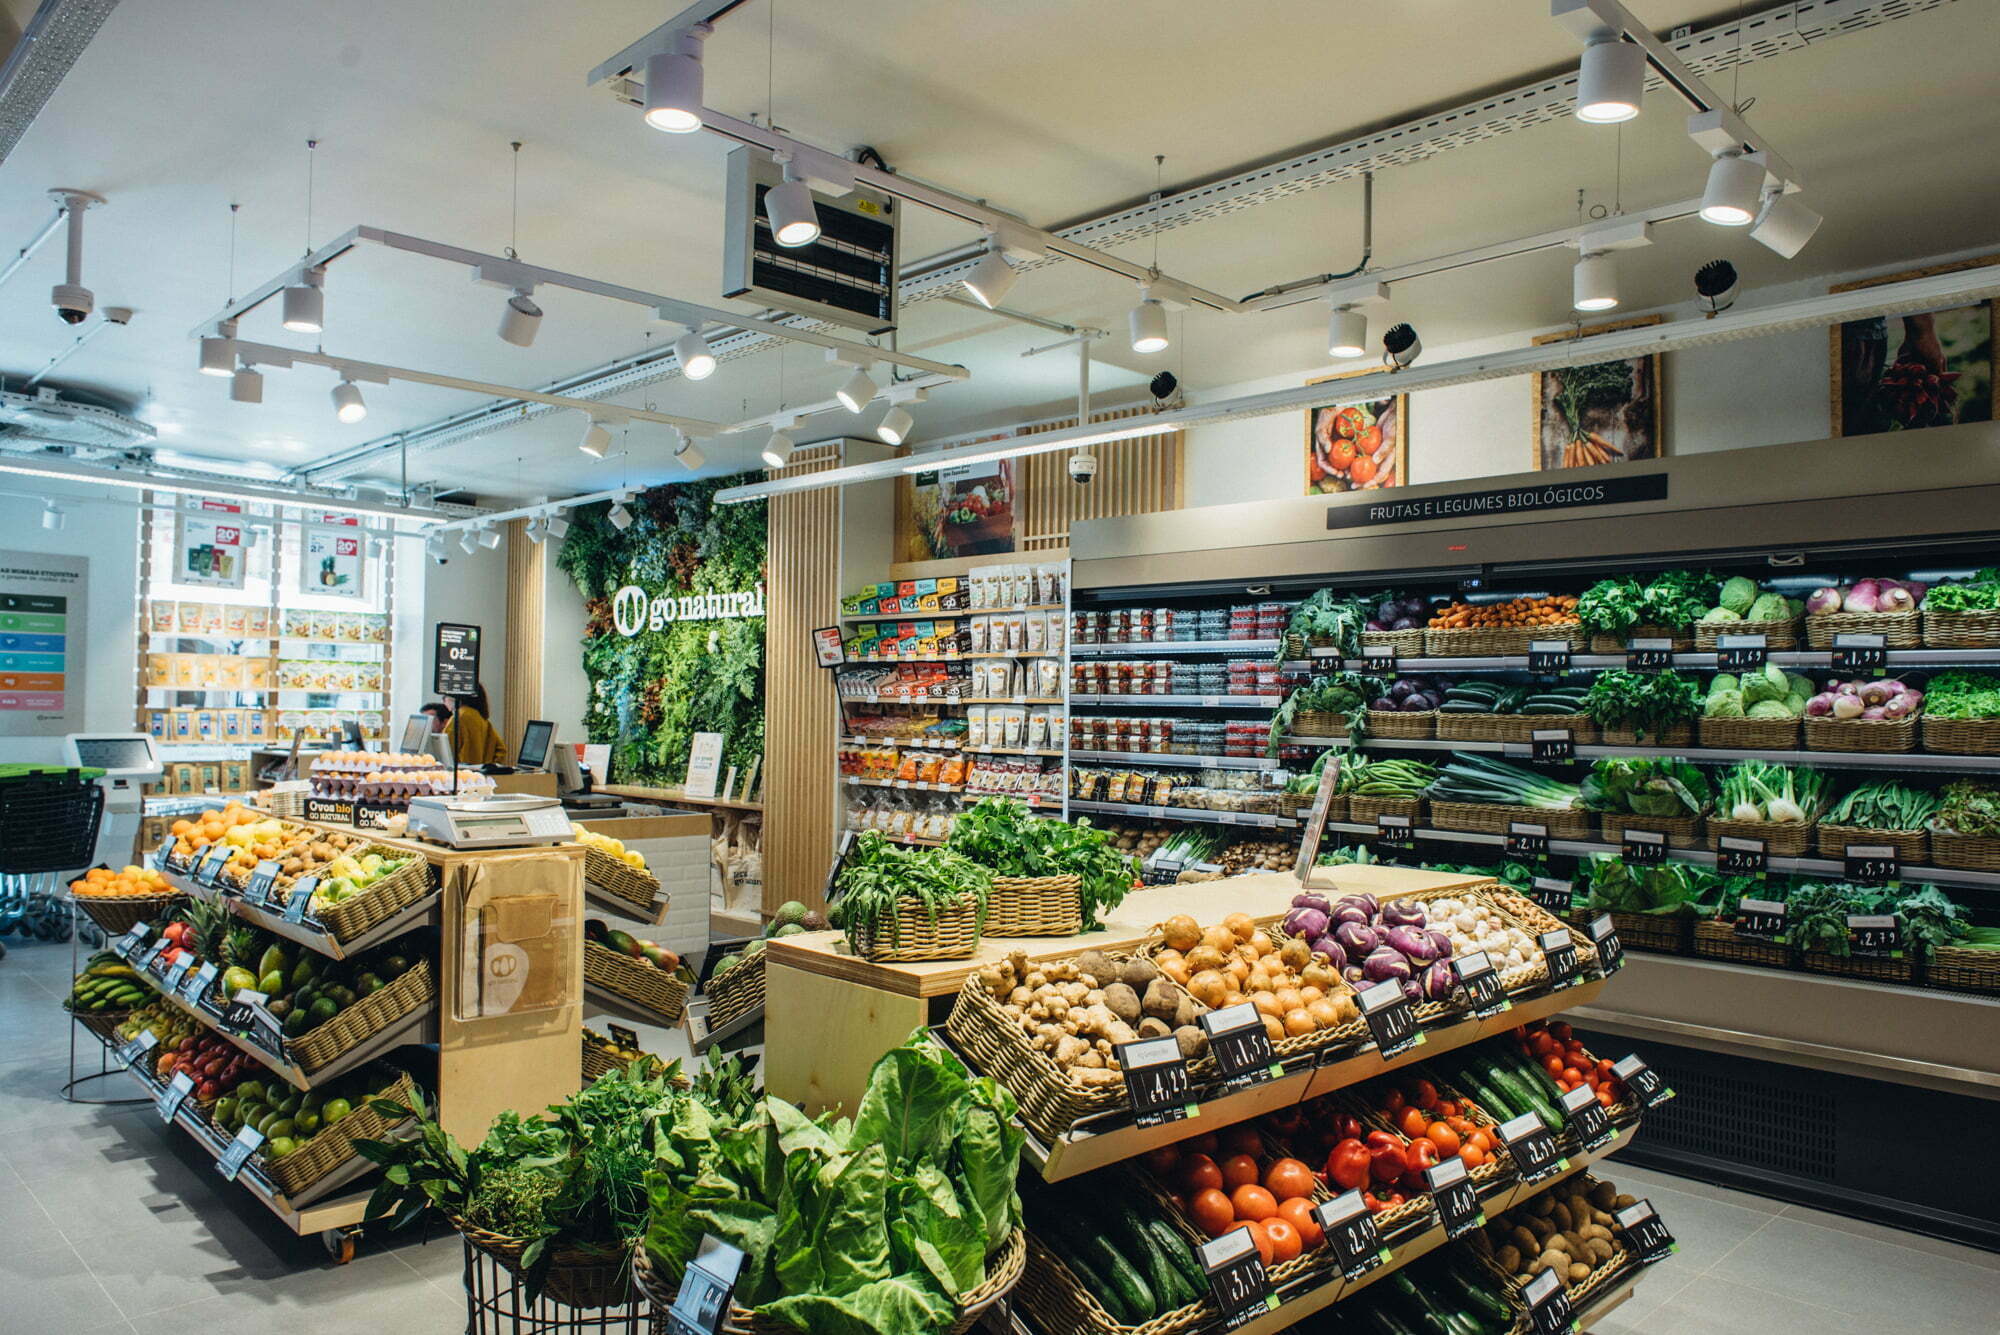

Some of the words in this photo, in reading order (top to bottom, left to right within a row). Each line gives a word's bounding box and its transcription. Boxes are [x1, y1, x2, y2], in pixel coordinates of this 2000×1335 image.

[1370, 503, 1420, 520] FRUTAS
[1424, 502, 1433, 515] E
[1436, 495, 1504, 514] LEGUMES
[1508, 486, 1605, 508] BIOLÓGICOS
[309, 800, 335, 812] Ovos
[335, 803, 352, 813] bio
[1150, 1068, 1187, 1103] €4,29
